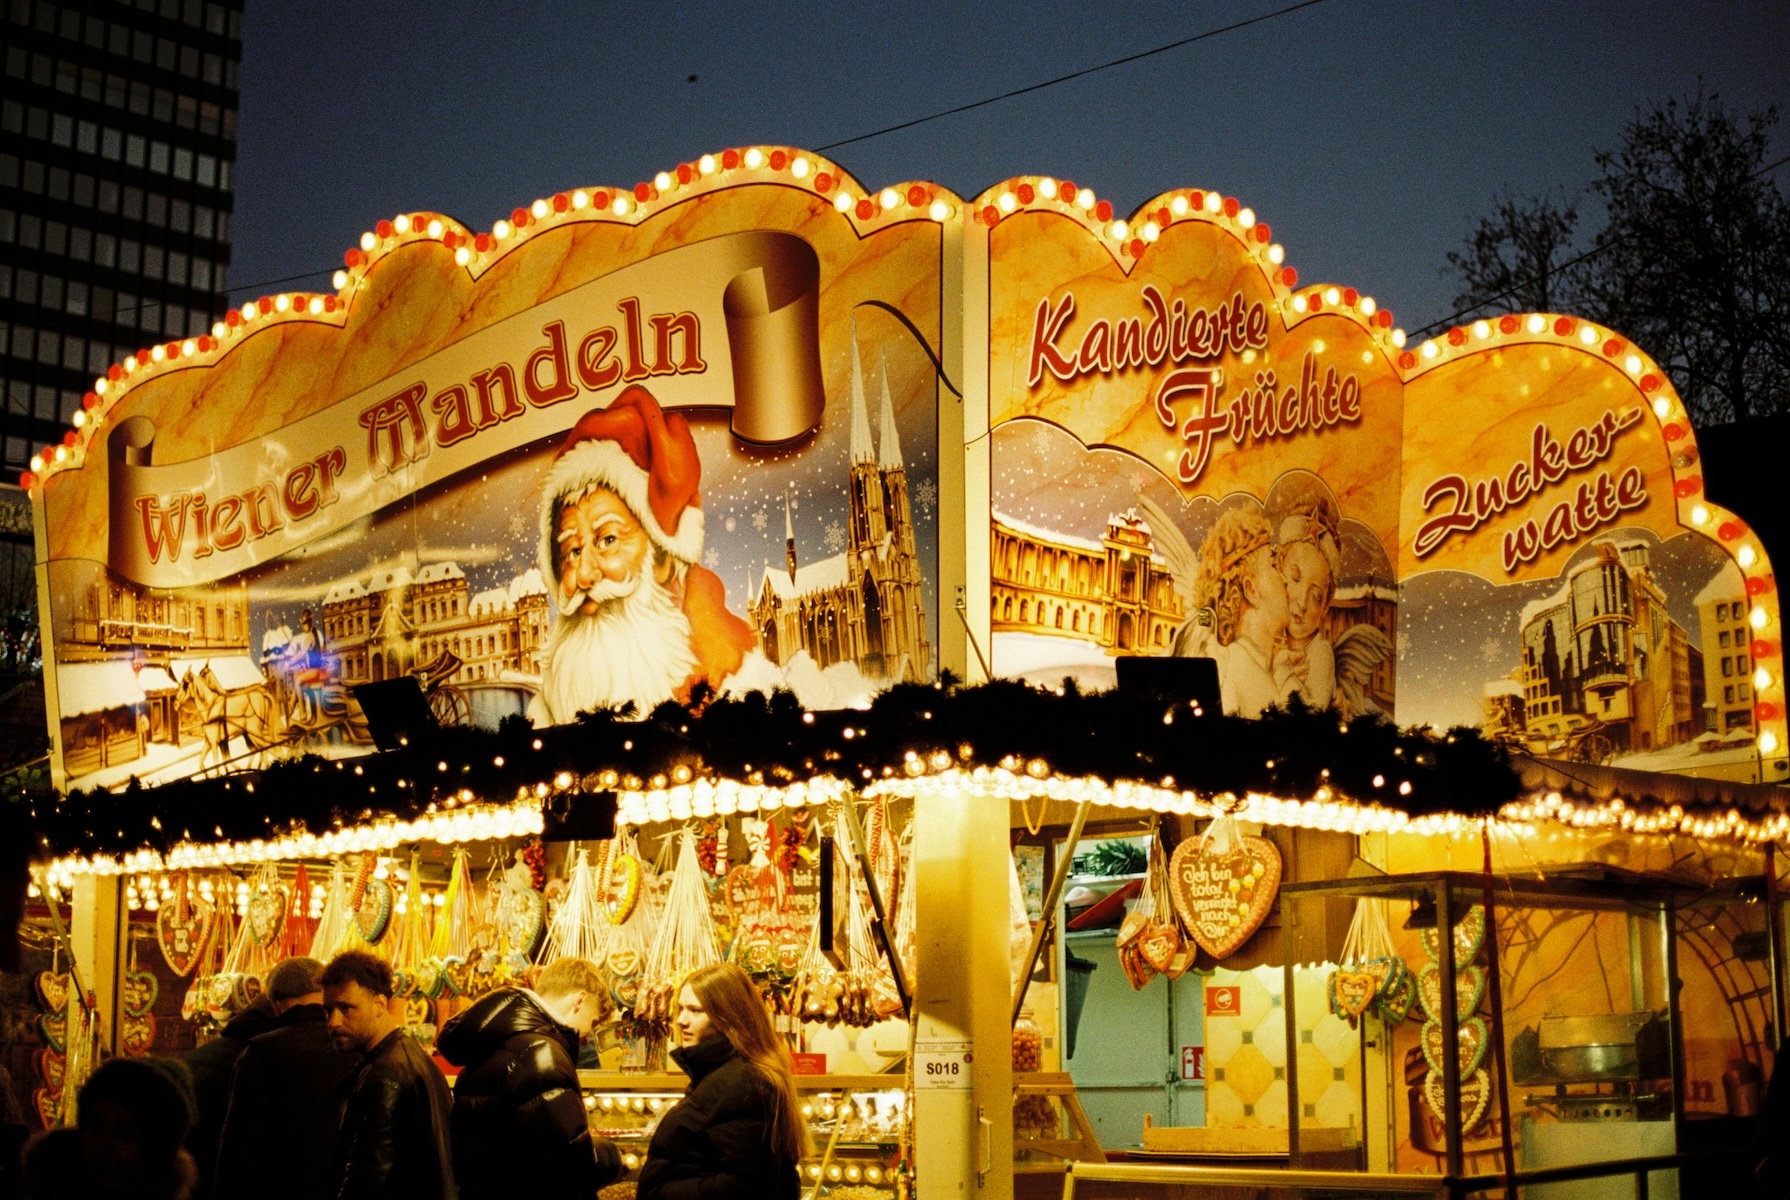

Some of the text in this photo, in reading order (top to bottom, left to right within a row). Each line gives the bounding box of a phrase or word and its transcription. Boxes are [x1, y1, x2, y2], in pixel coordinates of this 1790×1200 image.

[1027, 284, 1267, 387] Kandierte
[134, 296, 706, 563] Wiener Mandeln
[1155, 350, 1360, 482] Früchte
[1413, 406, 1642, 556] Zucker-
[1502, 465, 1647, 571] watte
[1182, 862, 1232, 883] Ich bin
[1190, 881, 1223, 897] total
[1201, 907, 1231, 922] nach
[926, 1062, 959, 1075] S018
